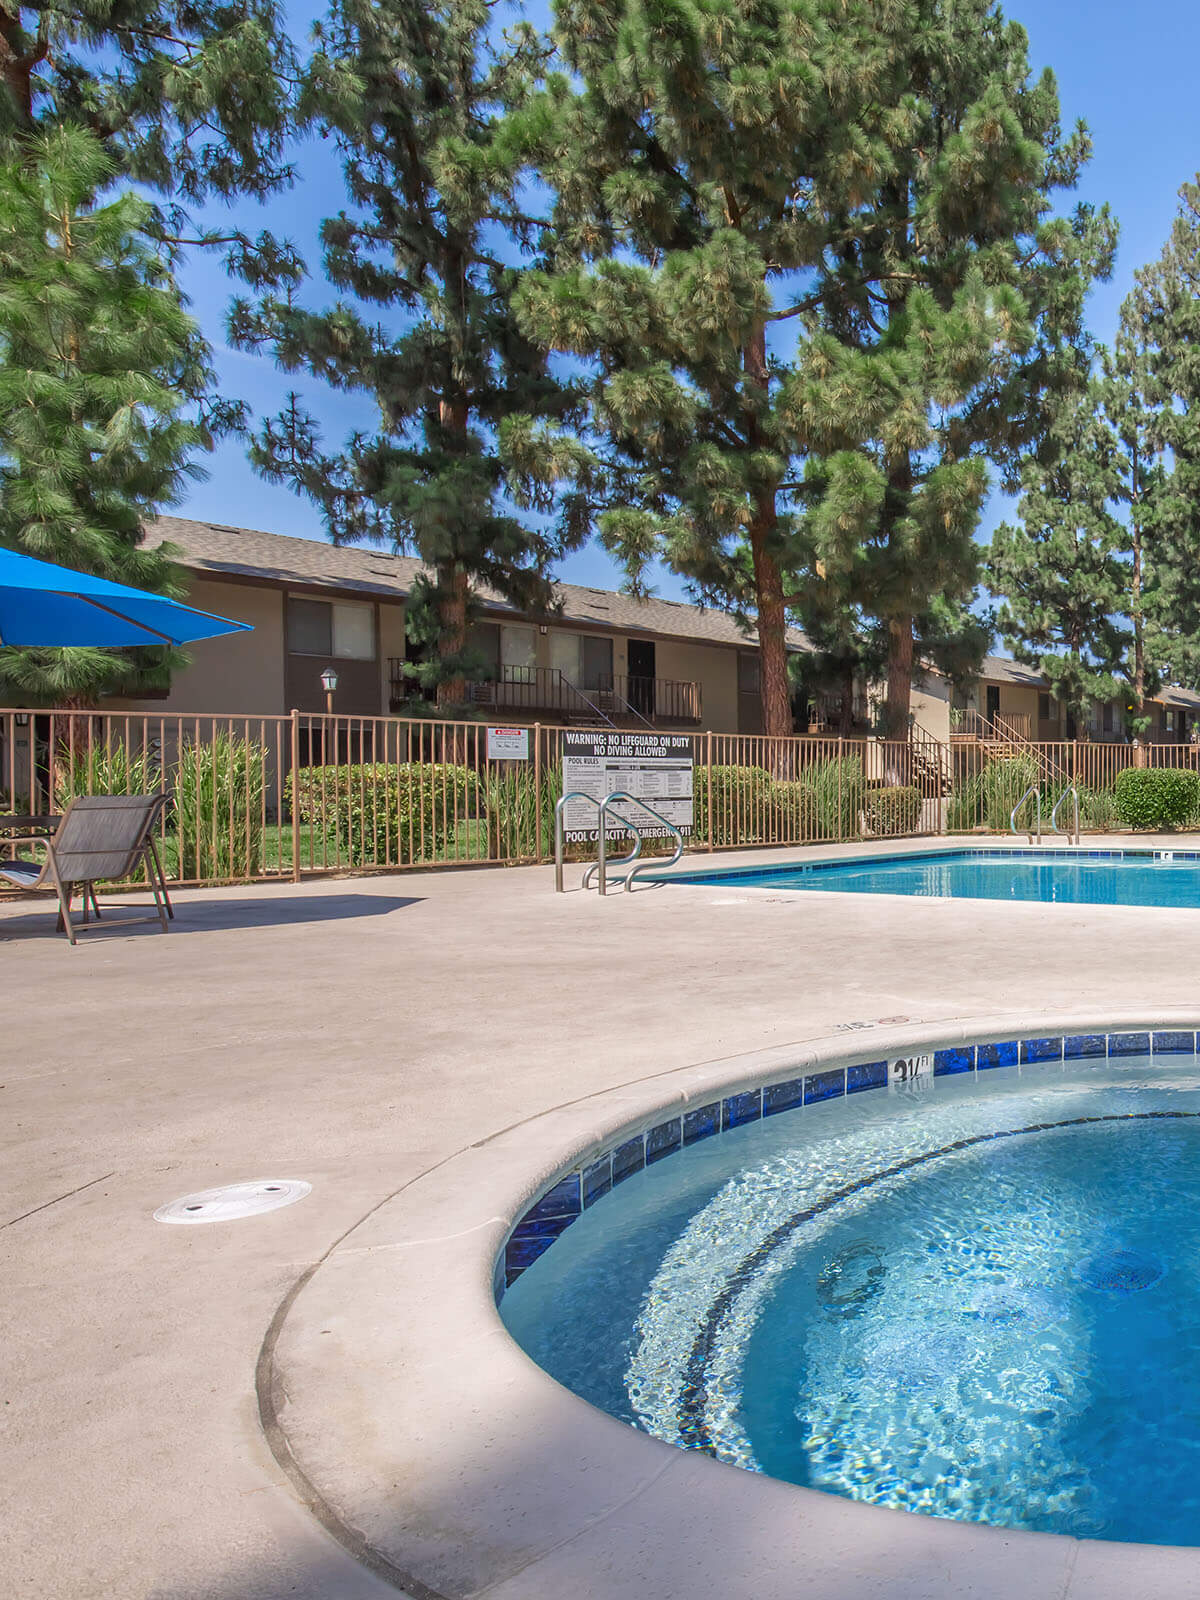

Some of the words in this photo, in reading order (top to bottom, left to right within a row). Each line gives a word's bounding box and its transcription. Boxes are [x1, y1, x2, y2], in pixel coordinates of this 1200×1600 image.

[566, 733, 607, 745] WARNING:
[608, 735, 620, 745] NO
[621, 735, 659, 746] LIFEGUARD
[660, 736, 671, 747] ON
[672, 737, 689, 748] DUTY
[594, 745, 606, 756] NO
[607, 745, 633, 756] DIVING
[634, 746, 667, 757] ALLOWED
[566, 831, 588, 842] POOL
[590, 830, 626, 841] CAACITY
[680, 826, 691, 836] 911
